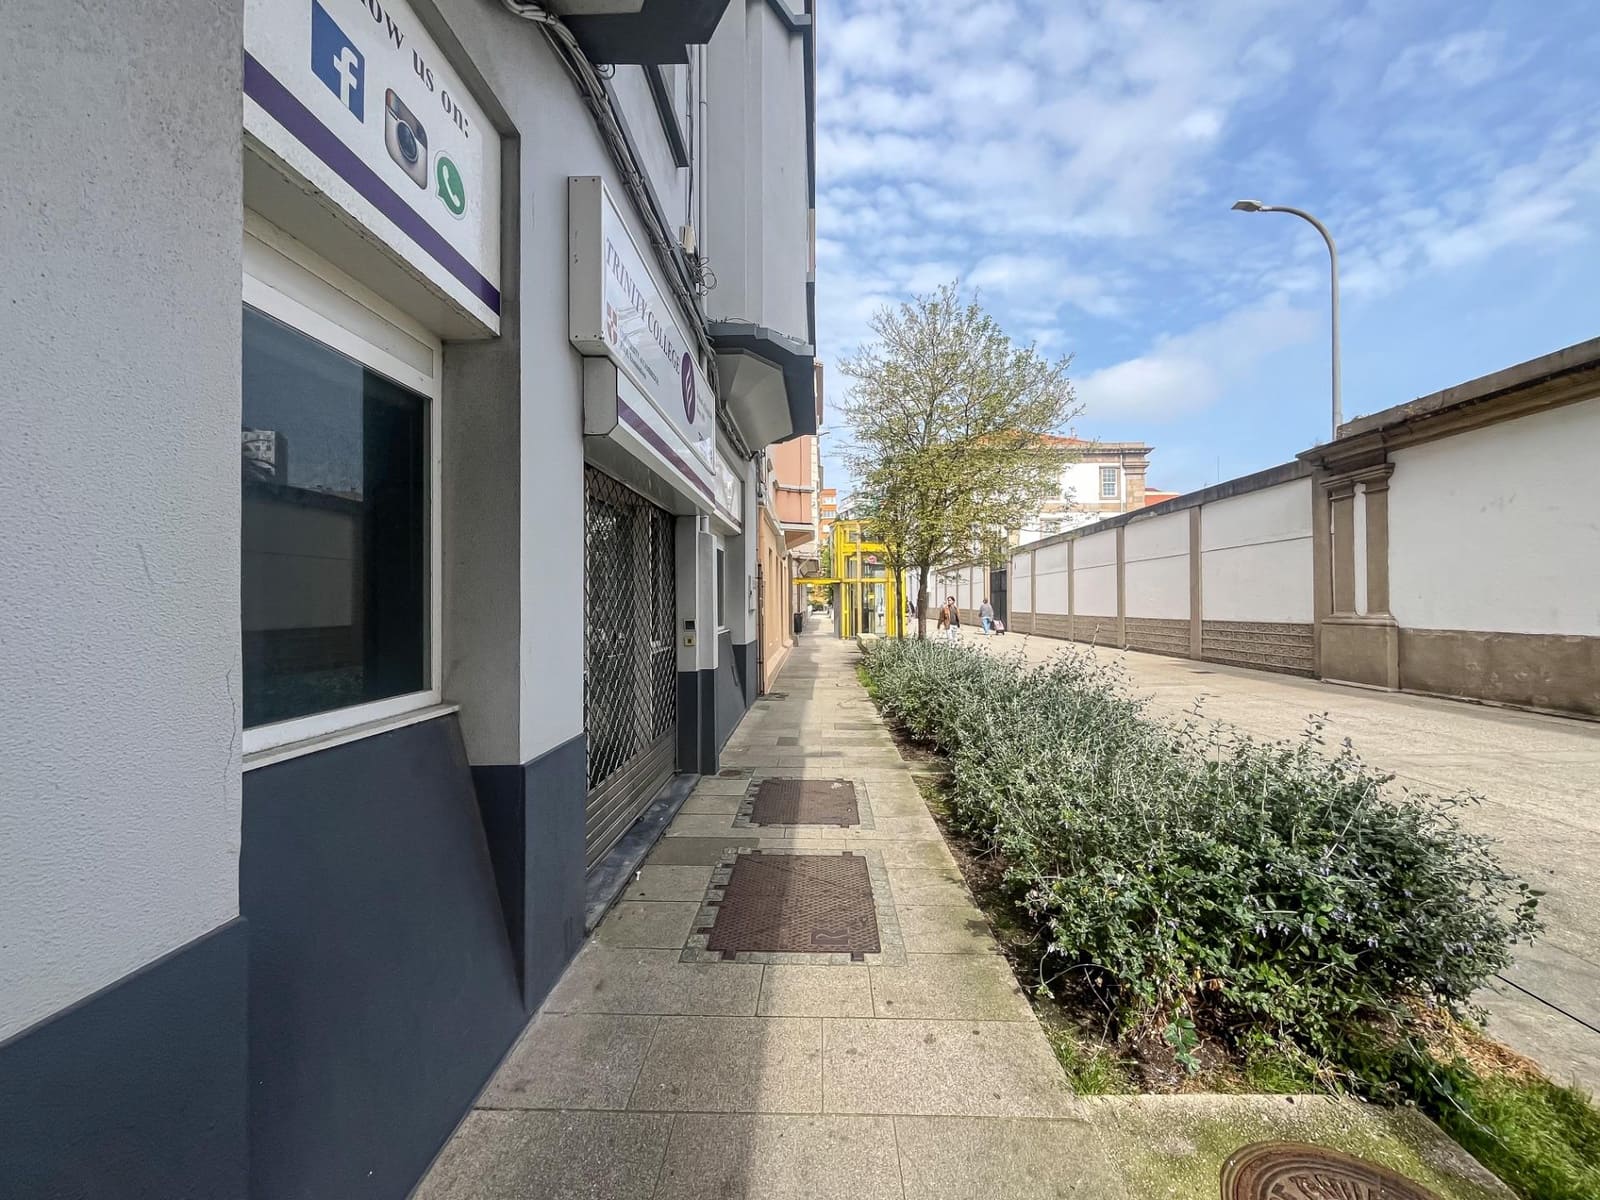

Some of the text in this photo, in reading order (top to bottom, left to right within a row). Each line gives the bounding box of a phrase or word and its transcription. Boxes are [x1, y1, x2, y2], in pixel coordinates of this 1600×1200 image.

[361, 0, 469, 138] ow us on:
[606, 237, 648, 321] TRINITY
[647, 311, 680, 375] COLLEGE
